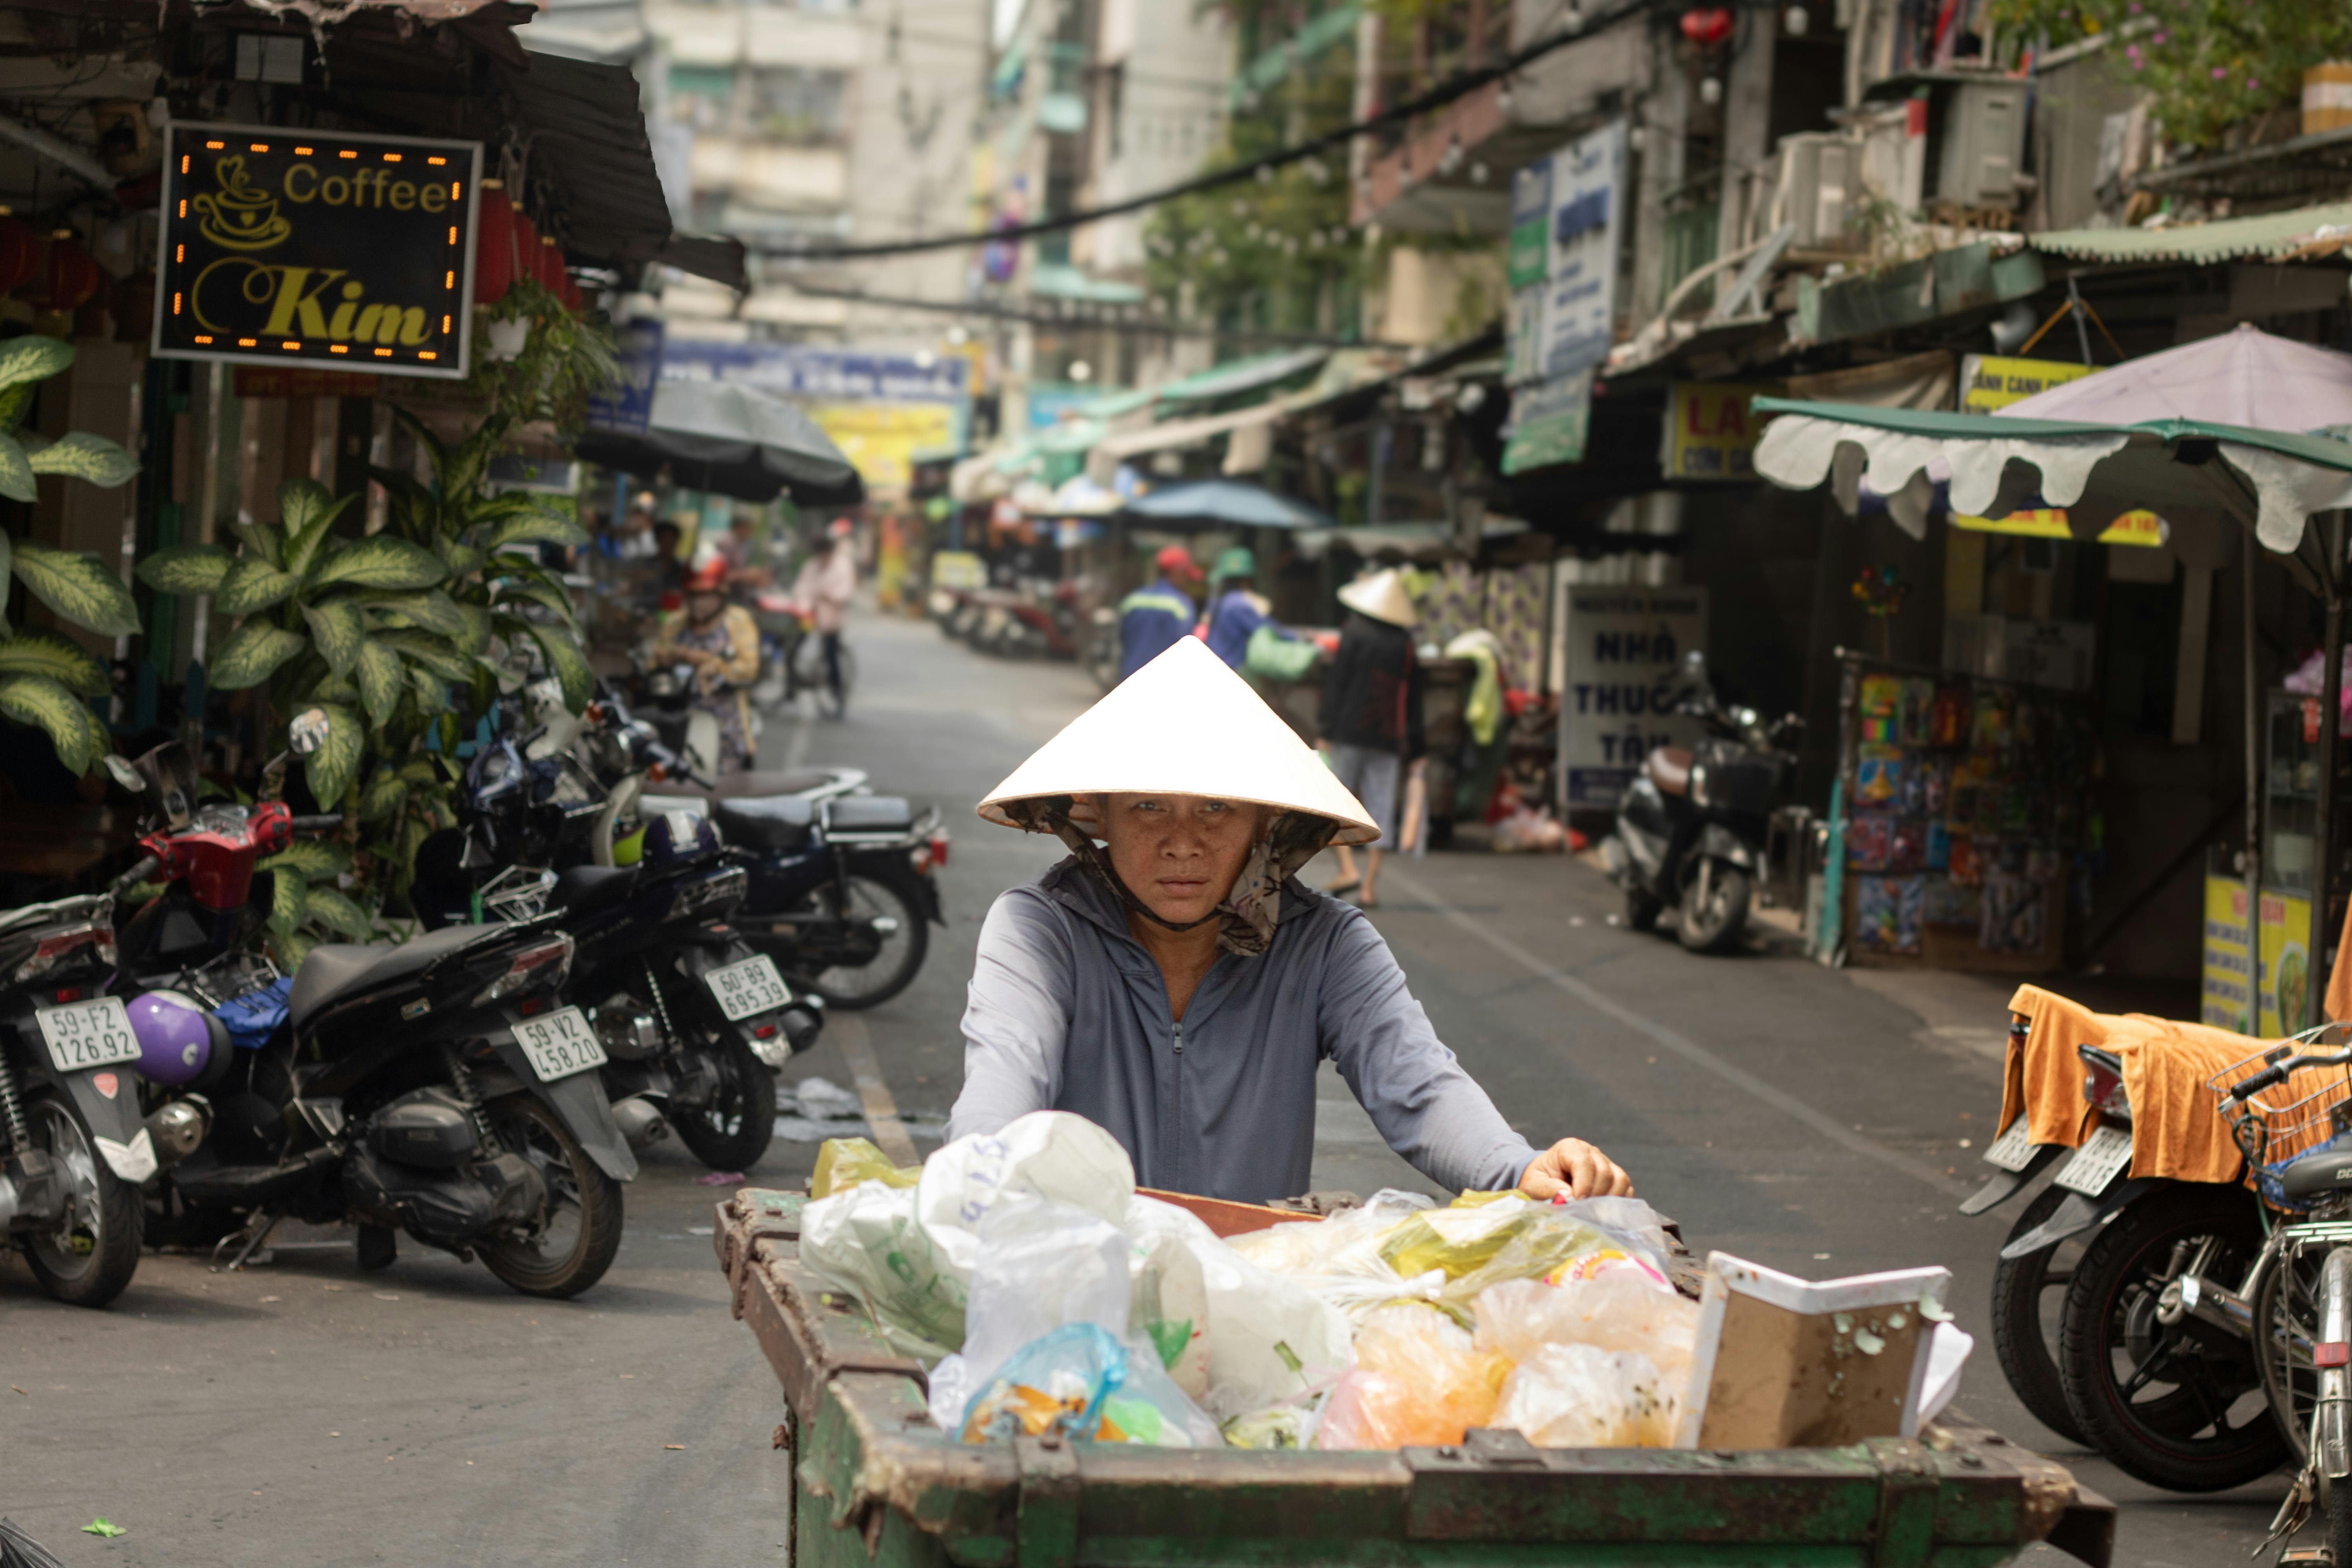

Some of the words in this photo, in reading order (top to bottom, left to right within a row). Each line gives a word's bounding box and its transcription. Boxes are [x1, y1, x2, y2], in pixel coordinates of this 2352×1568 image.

[284, 163, 448, 213] Coffee
[191, 256, 433, 345] Kim
[51, 1005, 116, 1036] 59-F2
[525, 1014, 576, 1048] 59-V2
[54, 1031, 134, 1065] 126.92
[536, 1038, 599, 1074] 458.20
